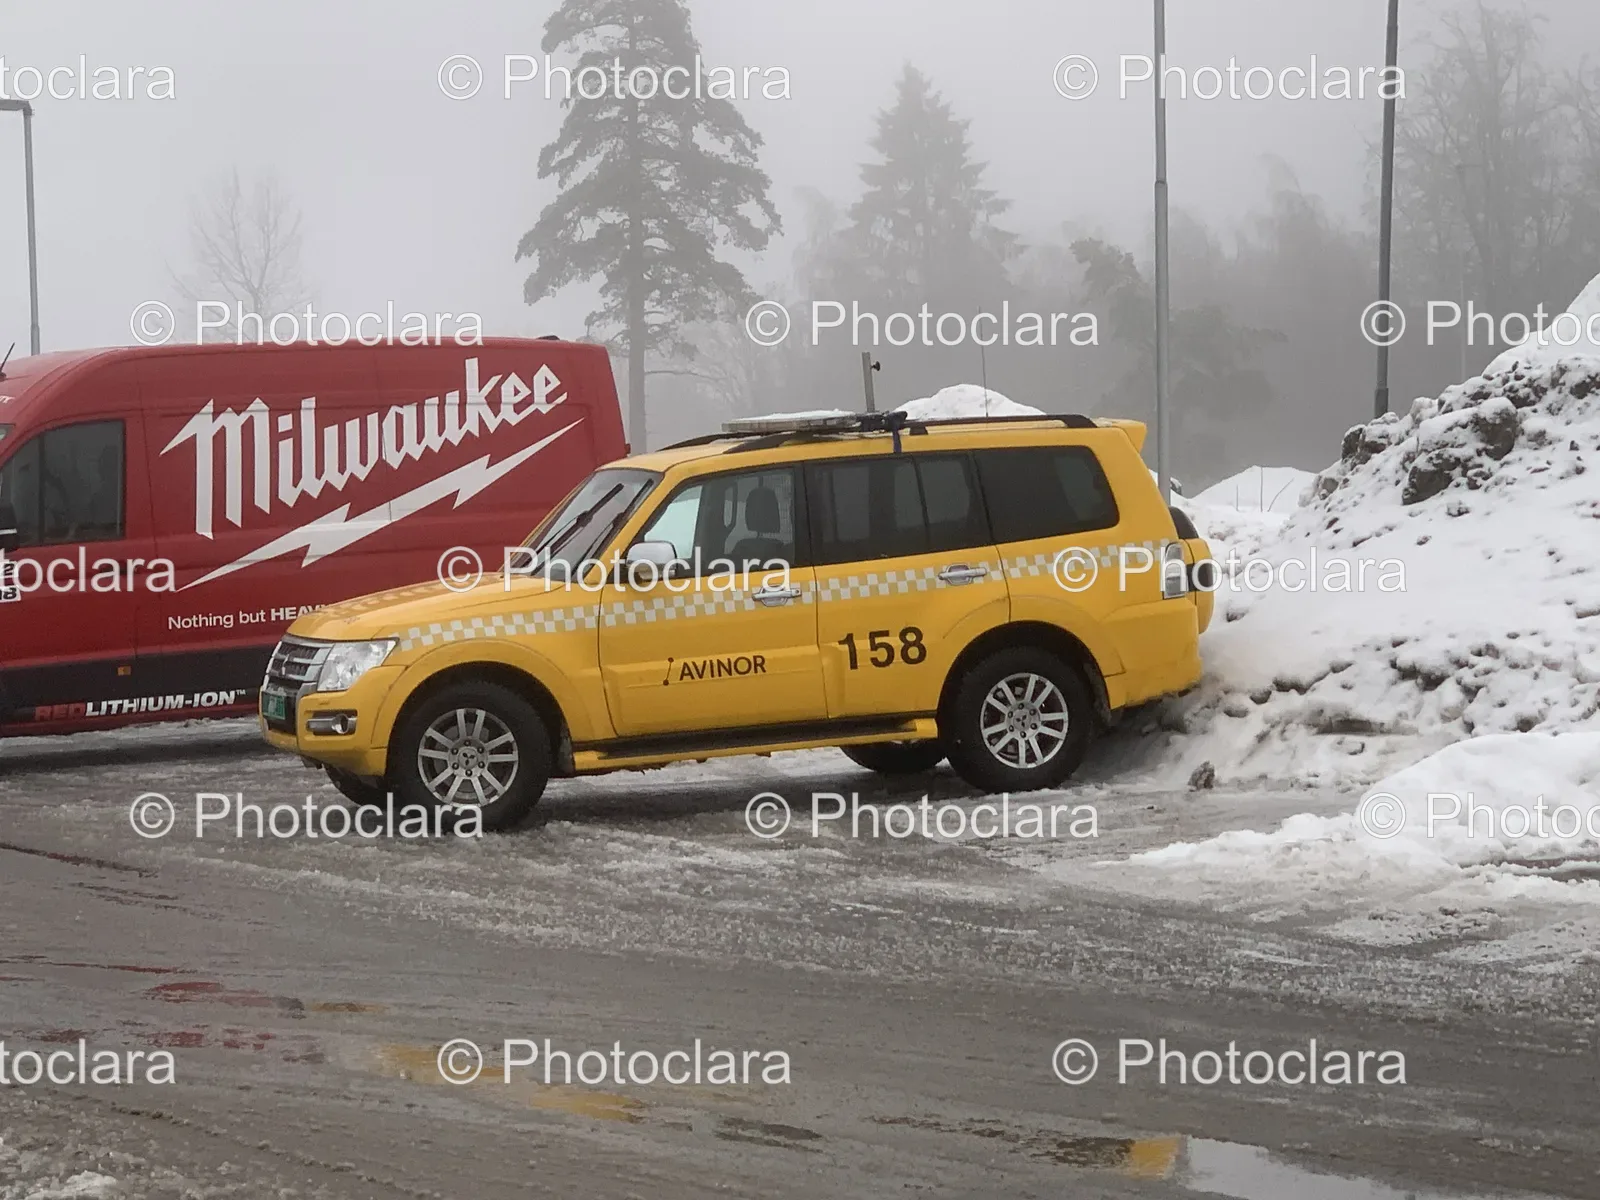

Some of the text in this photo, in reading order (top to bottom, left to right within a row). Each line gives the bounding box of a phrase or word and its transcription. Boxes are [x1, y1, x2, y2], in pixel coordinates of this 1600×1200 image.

[159, 357, 568, 540] Milwaukee
[168, 613, 233, 630] Nothing
[239, 610, 266, 624] but
[838, 626, 927, 670] 158
[679, 655, 767, 681] AVINOR
